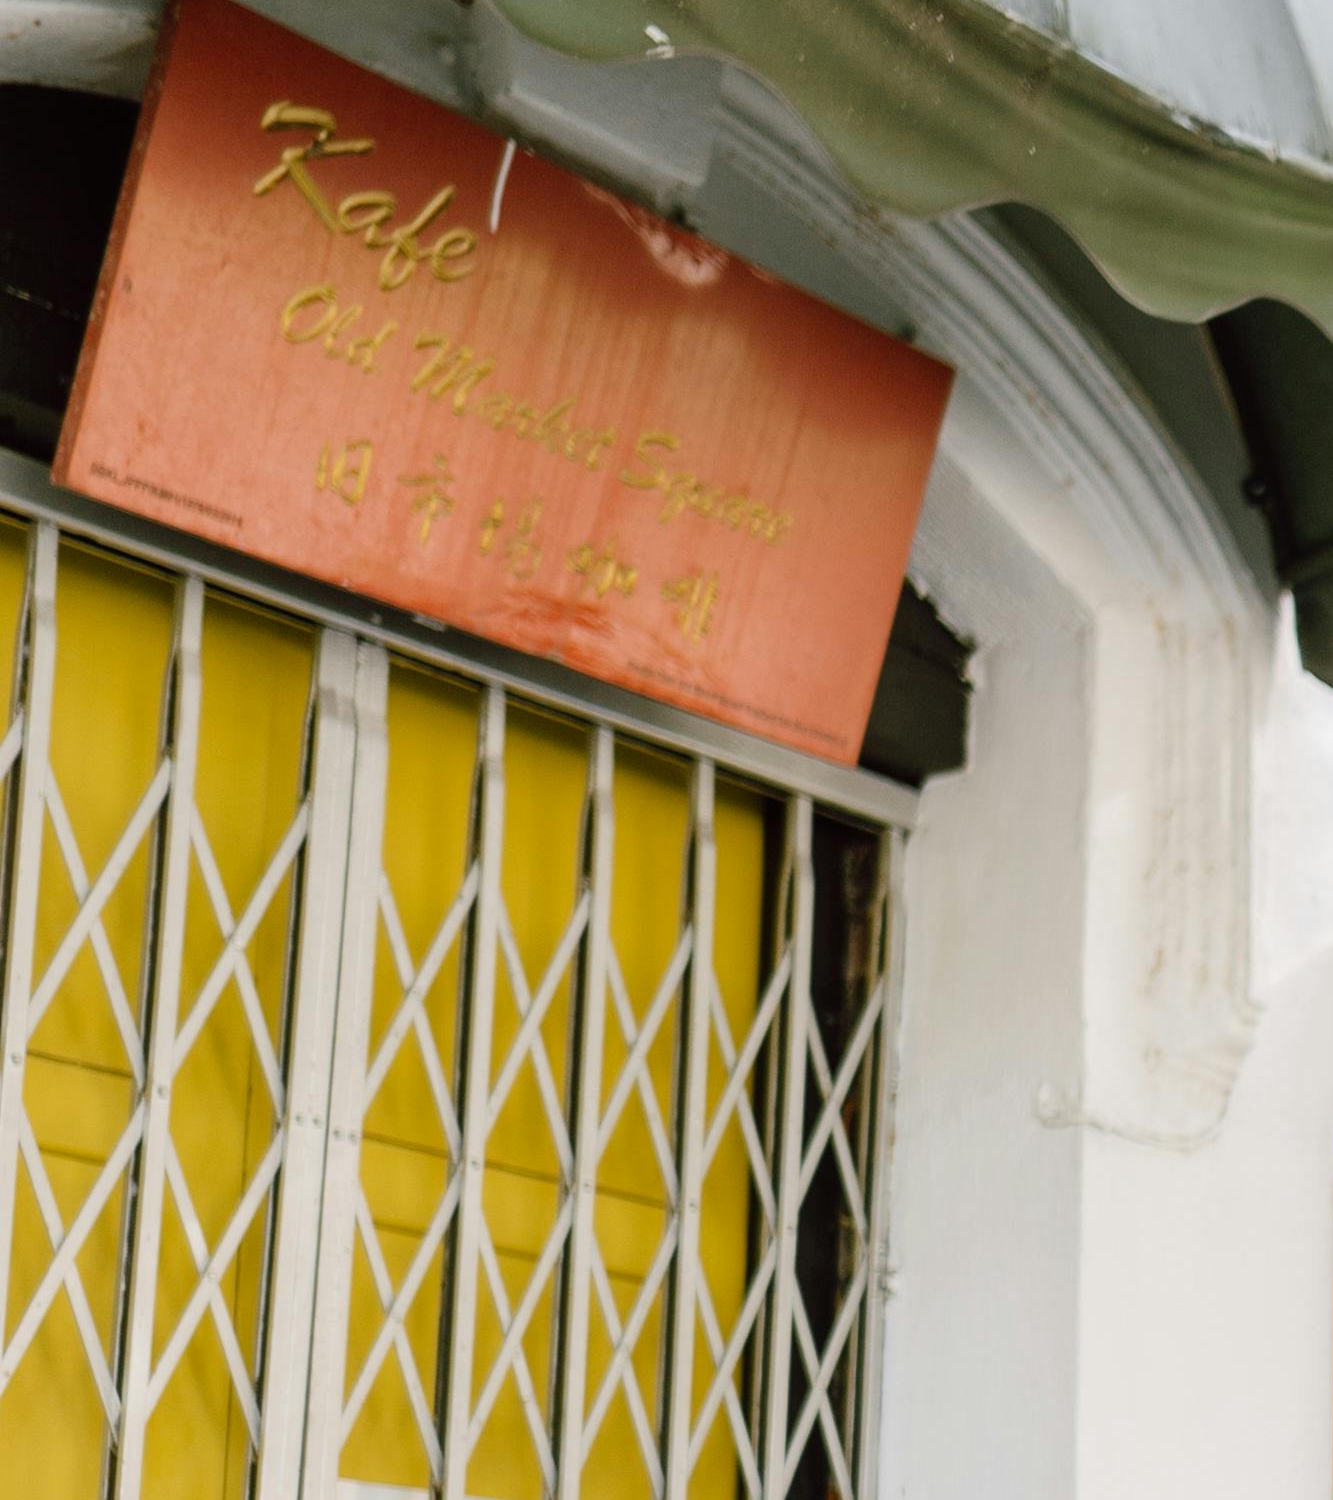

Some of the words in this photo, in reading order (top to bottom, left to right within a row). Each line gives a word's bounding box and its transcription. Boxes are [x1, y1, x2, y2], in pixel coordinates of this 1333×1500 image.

[253, 100, 477, 292] Kafe
[281, 285, 398, 373] Old
[410, 330, 616, 471] Market
[616, 431, 794, 545] Square
